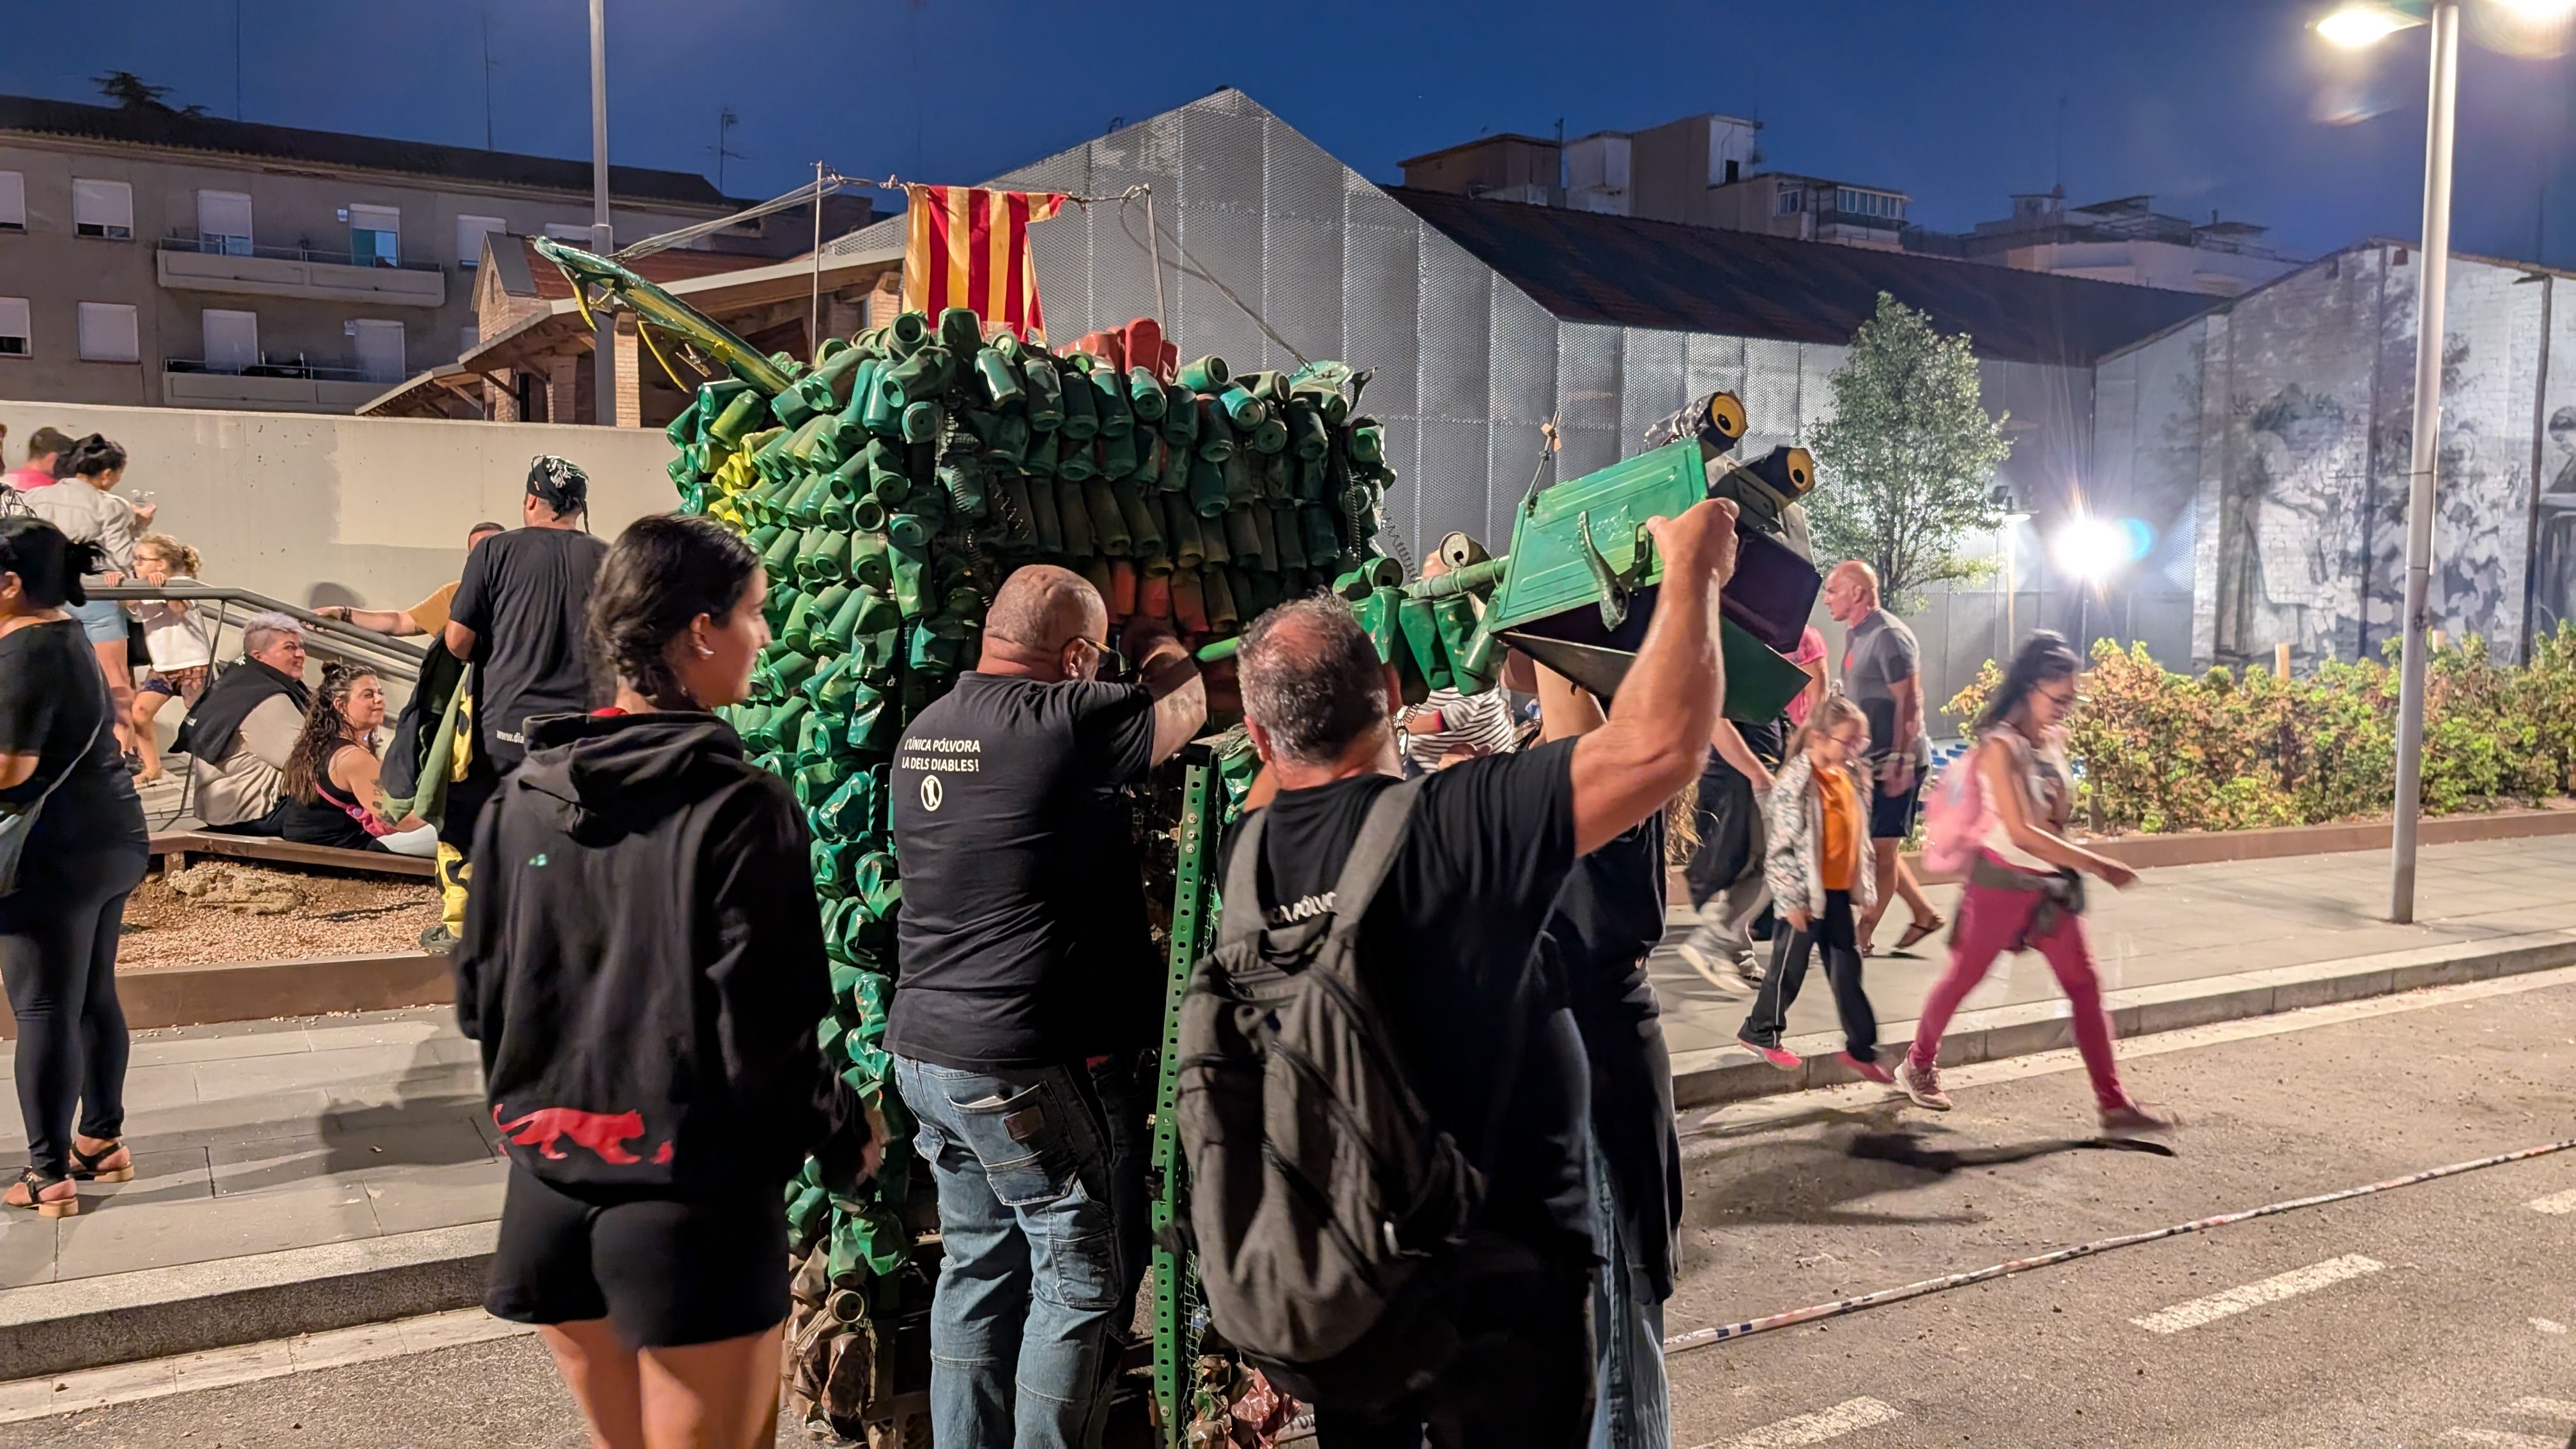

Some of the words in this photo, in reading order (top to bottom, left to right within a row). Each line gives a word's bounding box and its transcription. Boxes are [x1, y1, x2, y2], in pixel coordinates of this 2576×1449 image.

[904, 735, 931, 751] L'ÚNICA
[933, 737, 981, 753] PÓLVORA
[901, 756, 909, 769] LA
[910, 757, 930, 770] DELS
[931, 758, 979, 772] DIABLES!
